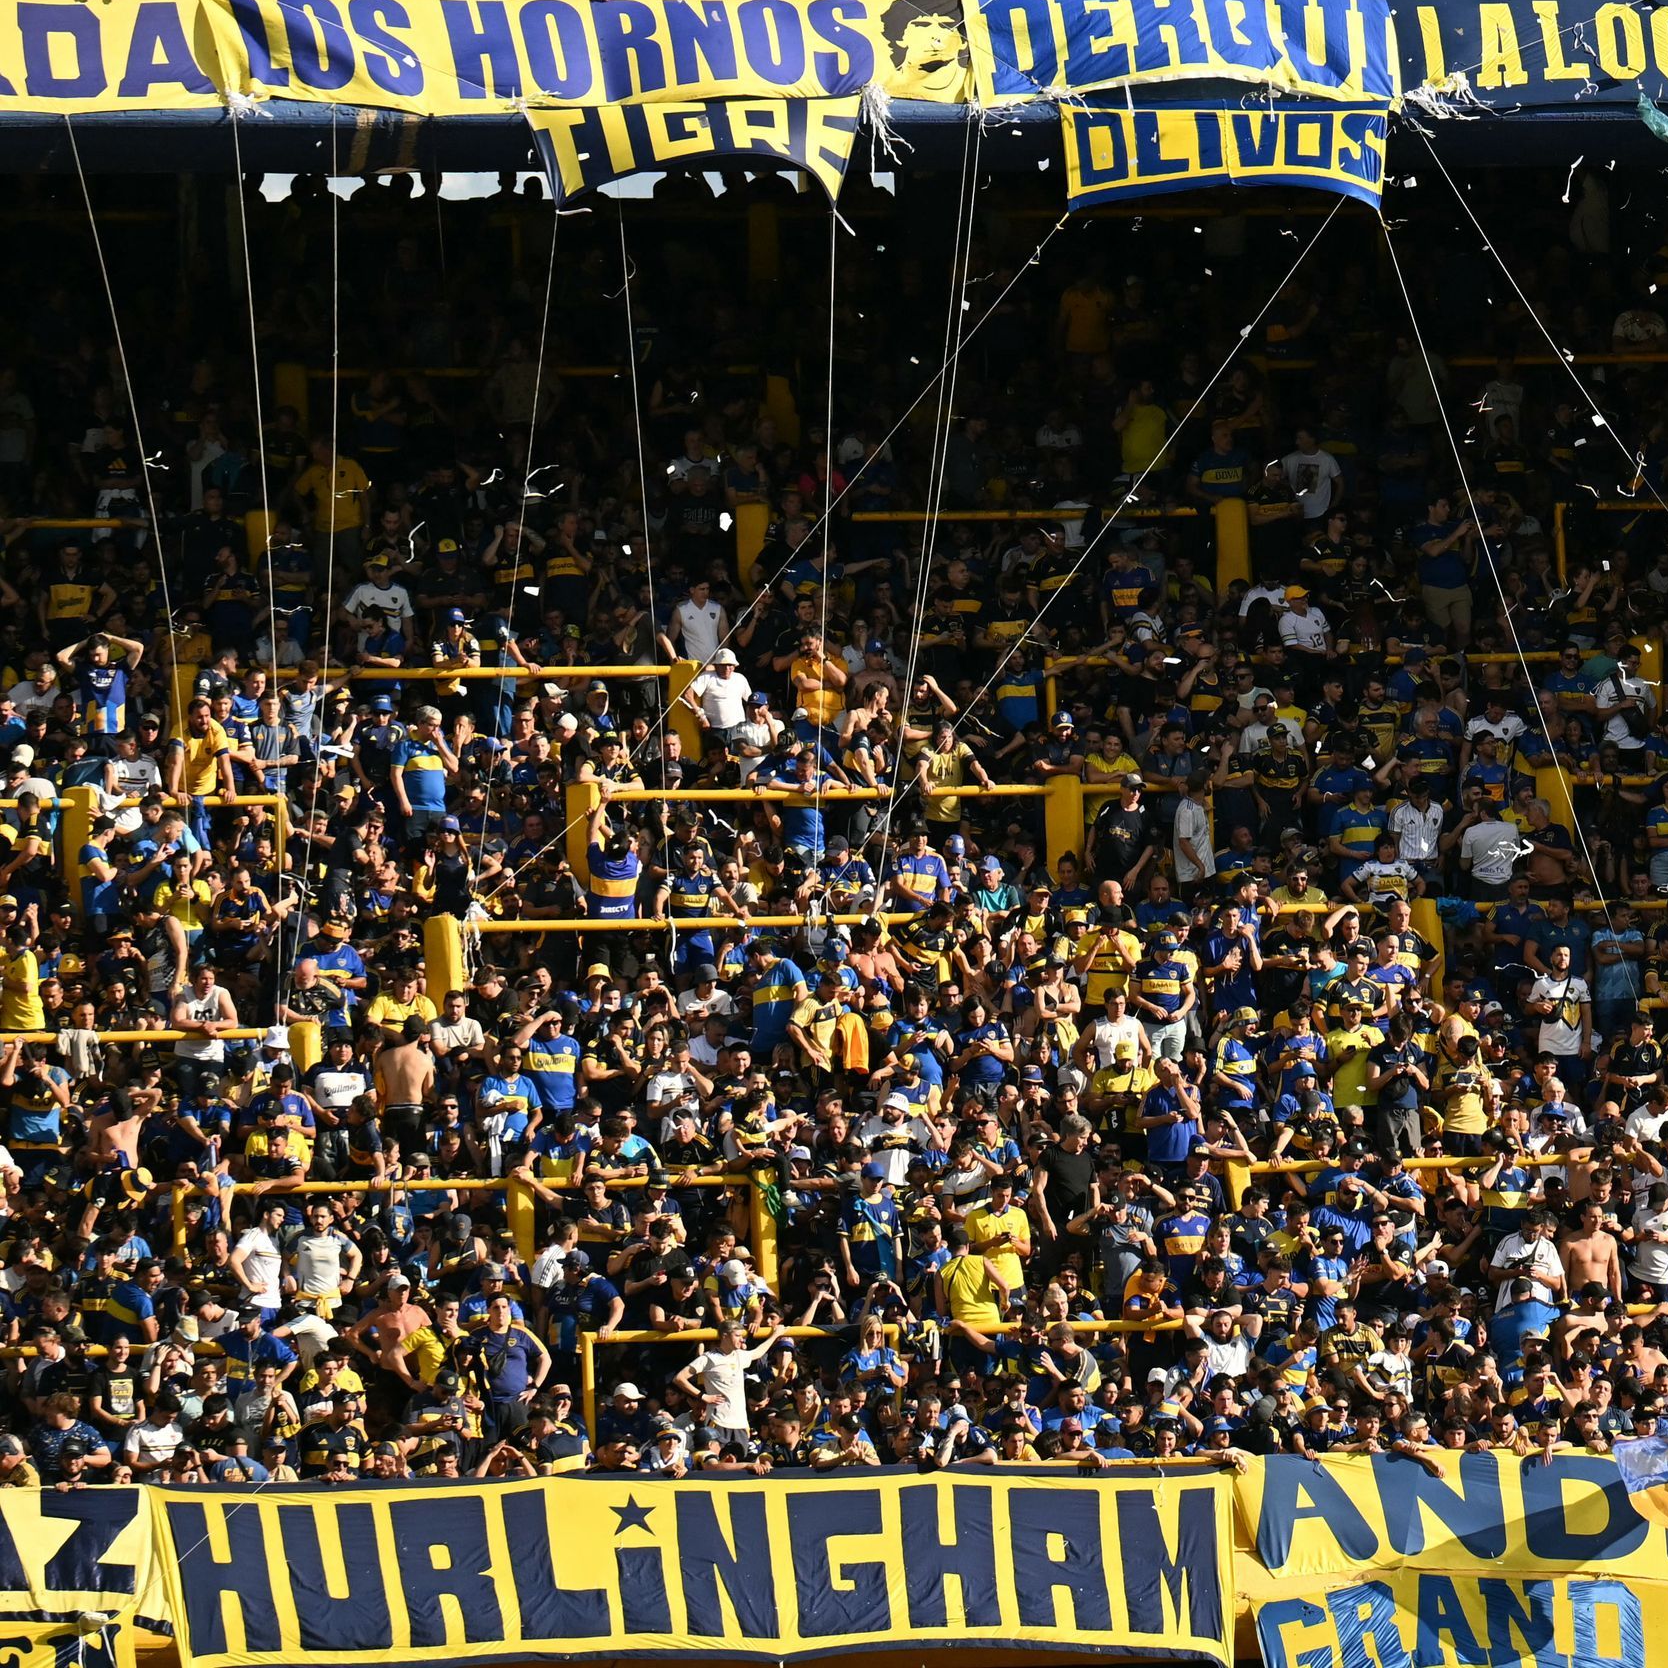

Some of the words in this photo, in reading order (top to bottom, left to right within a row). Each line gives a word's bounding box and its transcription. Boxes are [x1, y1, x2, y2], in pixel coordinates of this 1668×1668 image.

[0, 2, 220, 99] DA
[536, 99, 857, 200] TIGRE
[1310, 635, 1323, 648] 12
[600, 904, 629, 915] DIRECTV
[536, 1053, 570, 1070] Quilmes
[323, 1081, 358, 1098] Quilmes
[1110, 1109, 1119, 1129] FILA
[1257, 1575, 1645, 1668] GRAND
